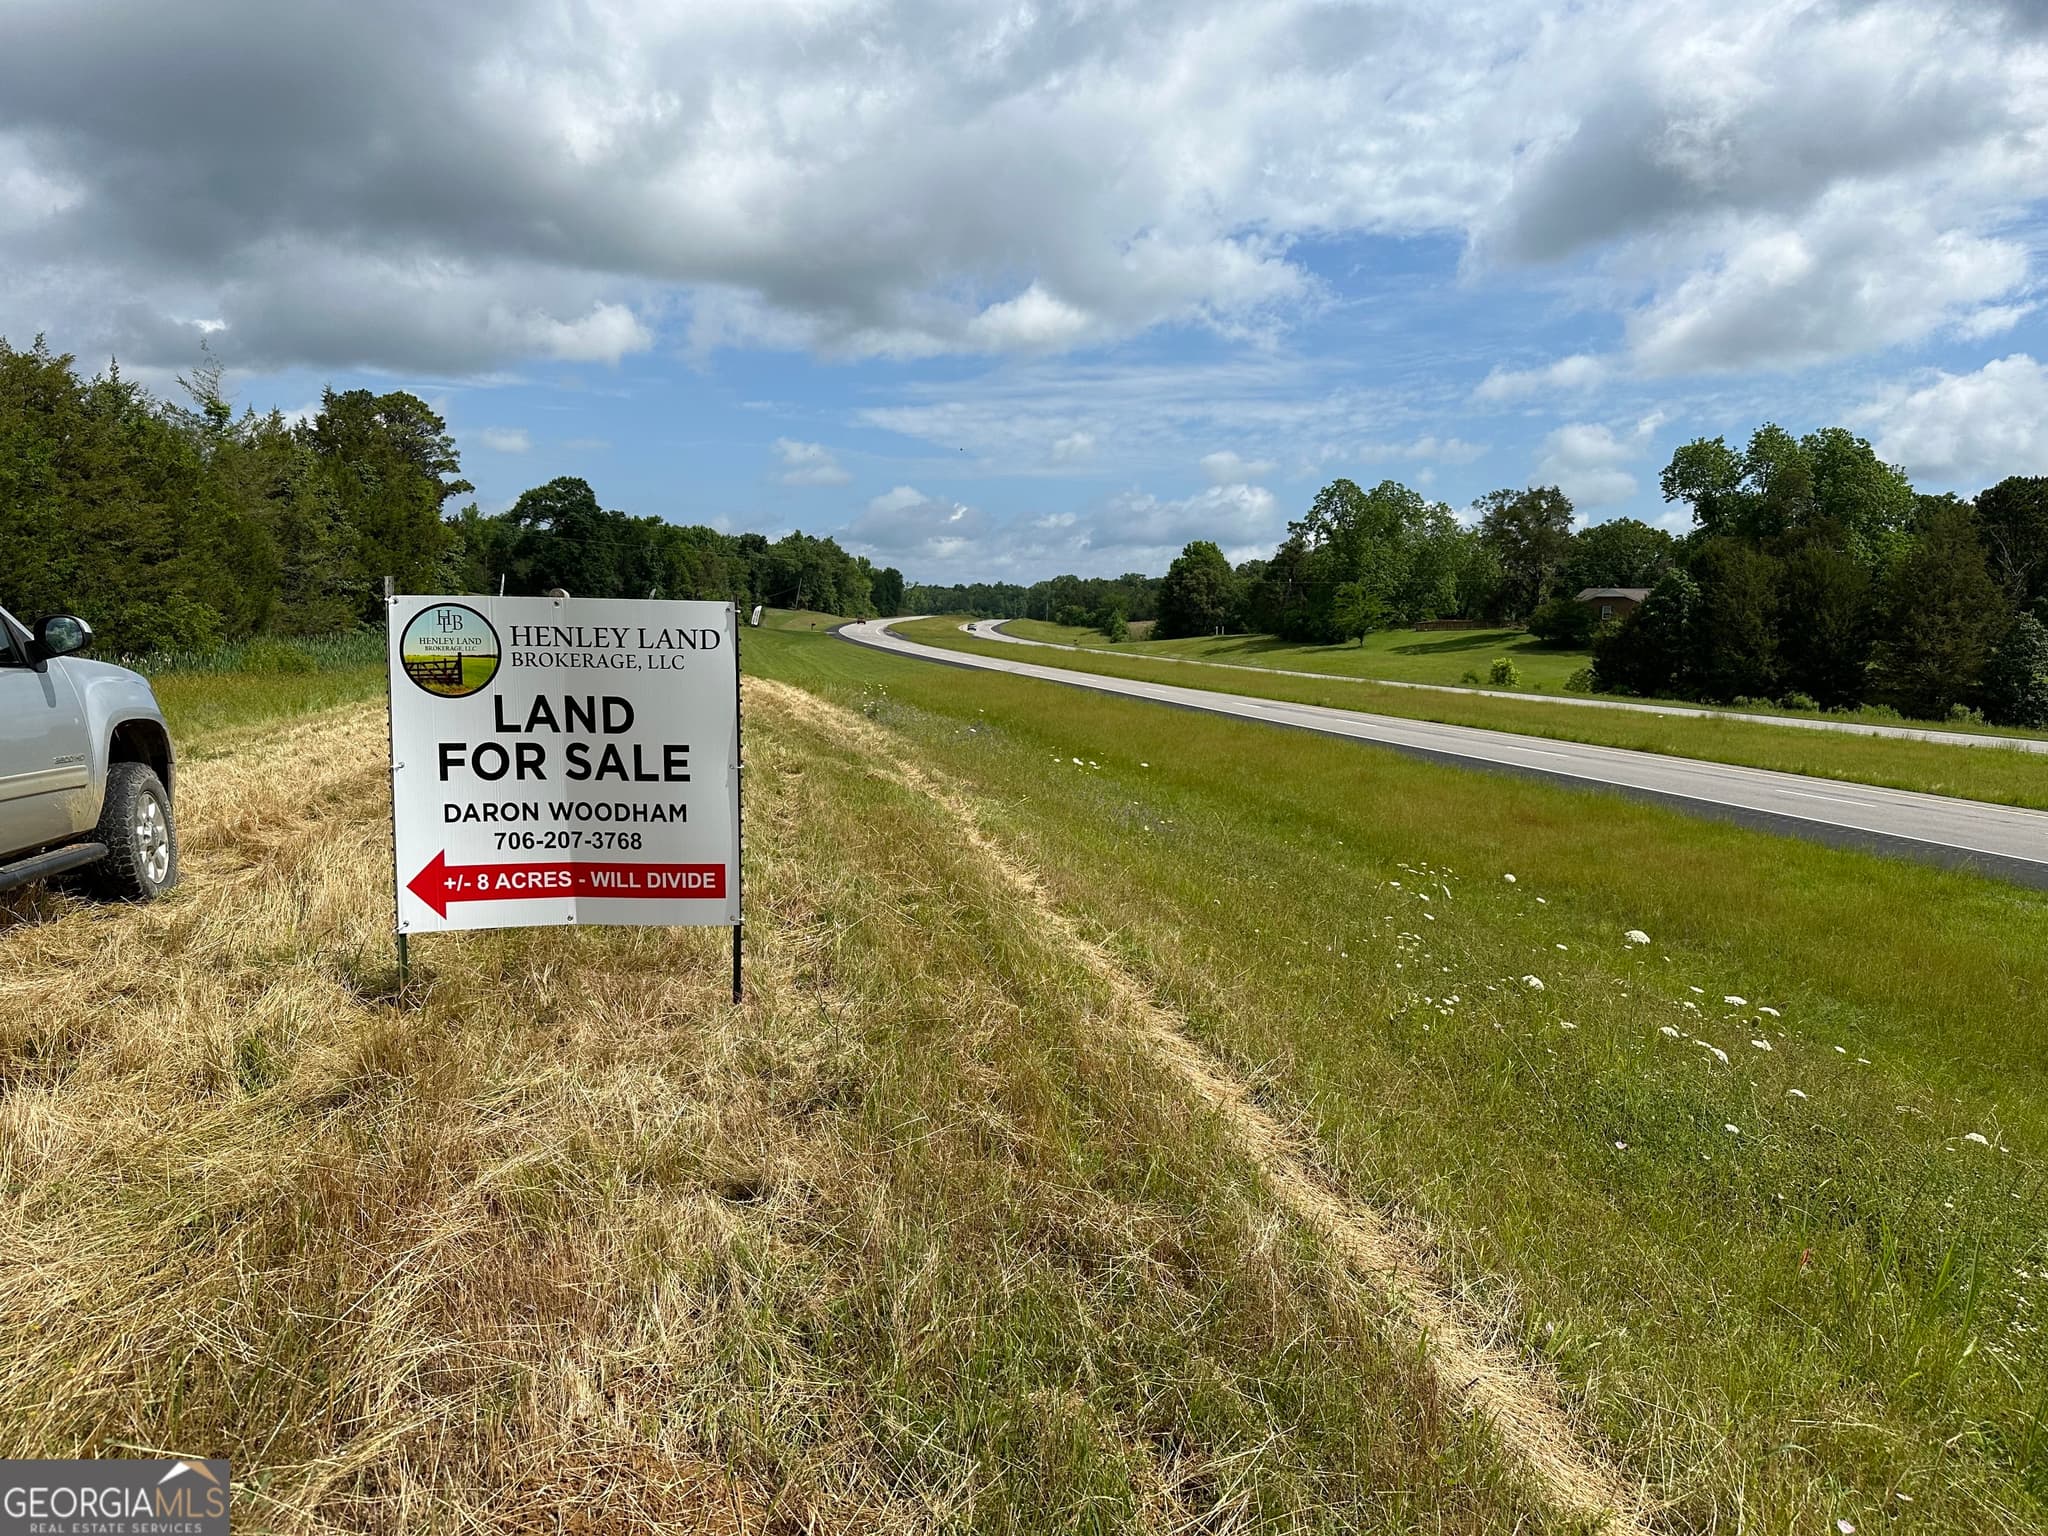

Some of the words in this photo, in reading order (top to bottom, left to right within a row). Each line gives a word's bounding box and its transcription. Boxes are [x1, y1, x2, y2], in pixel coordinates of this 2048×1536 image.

[509, 625, 630, 649] HENLEY
[638, 628, 720, 650] LAND
[512, 652, 642, 671] BROKERAGE,
[648, 654, 684, 670] LLC
[494, 694, 634, 733] LAND
[440, 742, 546, 781] FOR
[564, 742, 691, 782] SALE
[444, 802, 539, 823] DARON
[548, 802, 687, 822] WOODHAM
[494, 831, 642, 850] 706-207-3768
[443, 874, 471, 892] +/-
[477, 874, 489, 890] 8
[495, 871, 572, 889] ACRES
[590, 872, 641, 888] WILL
[647, 872, 716, 888] DIVIDE
